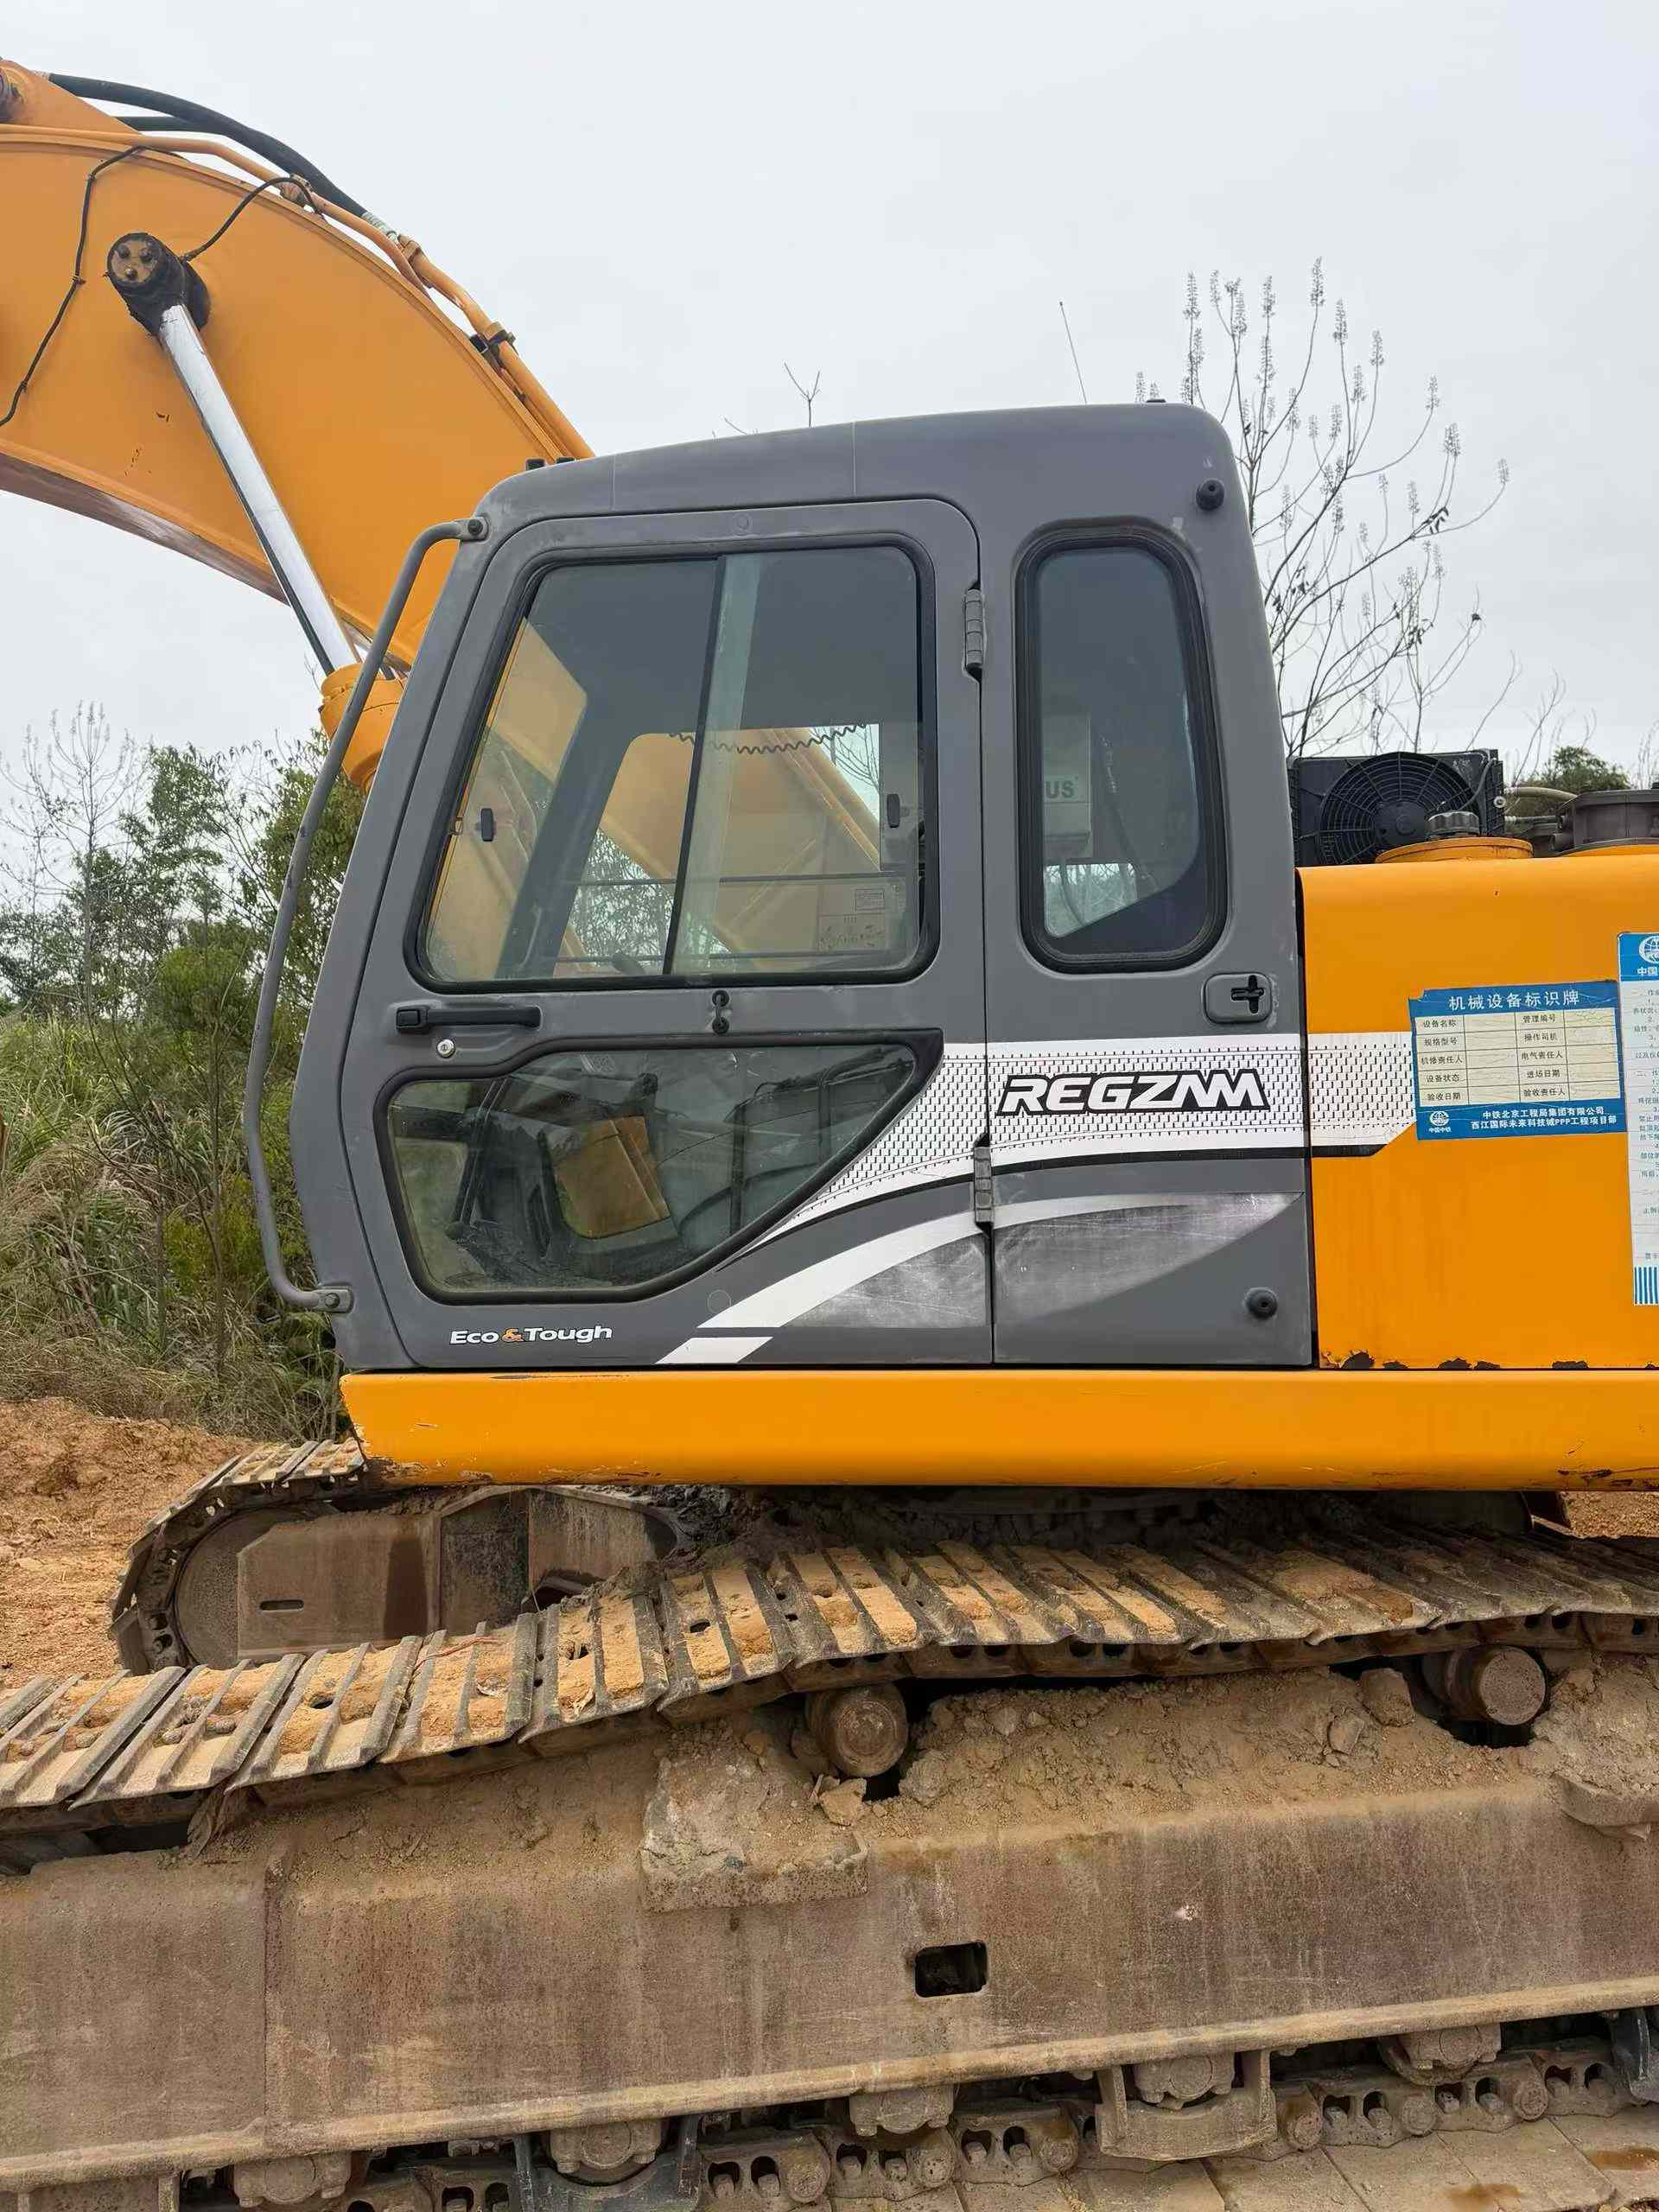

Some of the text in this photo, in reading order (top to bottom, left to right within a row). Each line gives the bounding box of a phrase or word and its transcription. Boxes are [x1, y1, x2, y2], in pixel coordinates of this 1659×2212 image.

[1449, 990, 1580, 1011] 机械设备标识牌
[1522, 1014, 1556, 1024] 管理编号
[1423, 1020, 1457, 1028] 设备名称
[1424, 1037, 1458, 1046] 规格型号
[1524, 1033, 1557, 1042] 操作司机
[1521, 1051, 1563, 1060] 电气责任人
[1421, 1056, 1463, 1065] 机修责任人
[1427, 1074, 1459, 1083] 设备状态
[1527, 1069, 1560, 1079] 进场日期
[1427, 1092, 1461, 1102] 验收日期
[1523, 1088, 1566, 1097] 验收责任人
[1483, 1106, 1605, 1119] 中铁北京工程局集团有限公司
[1471, 1116, 1618, 1129] 西江国际未来科技城PPP工程项目部
